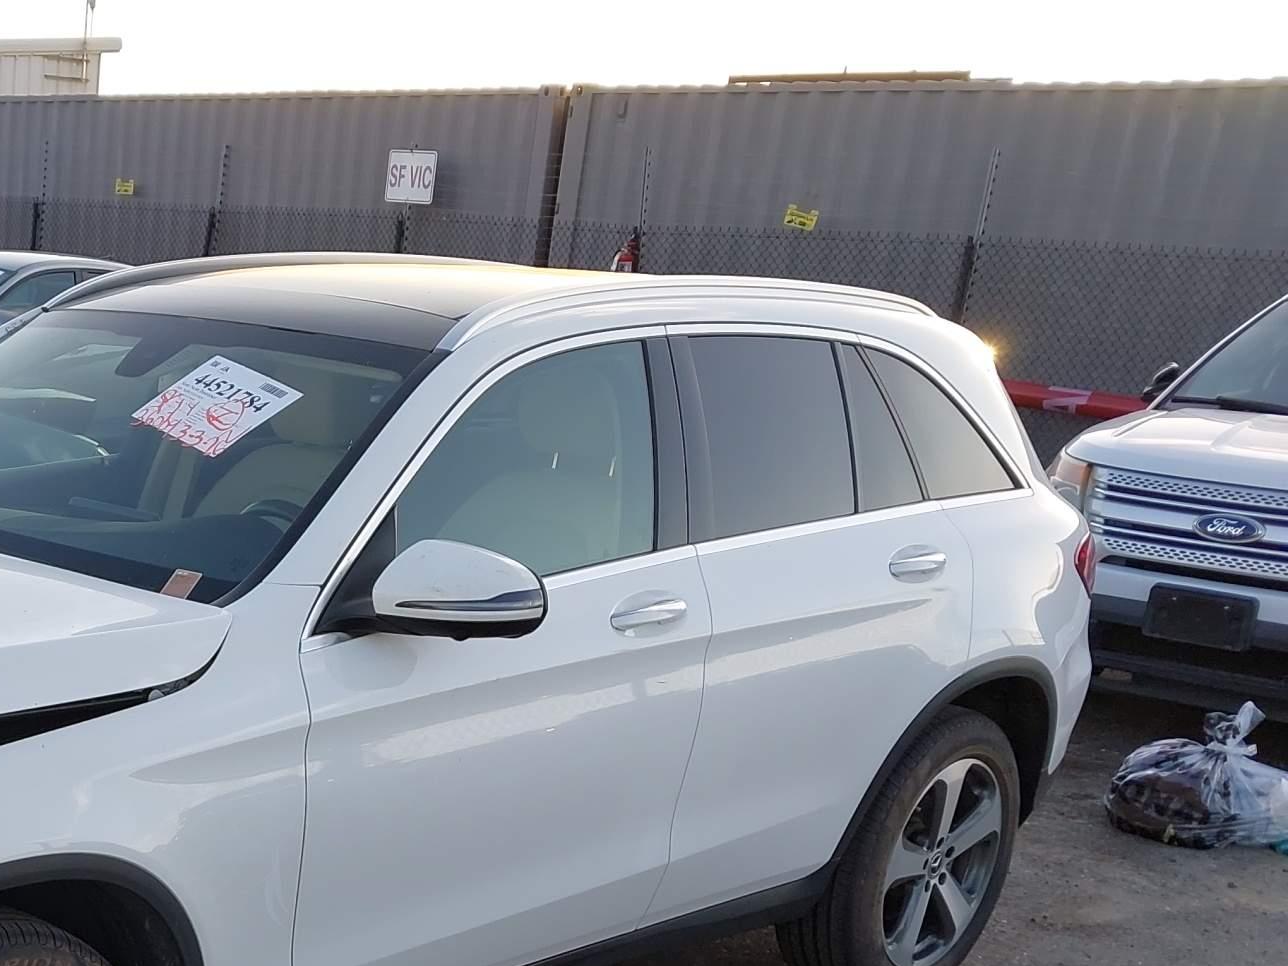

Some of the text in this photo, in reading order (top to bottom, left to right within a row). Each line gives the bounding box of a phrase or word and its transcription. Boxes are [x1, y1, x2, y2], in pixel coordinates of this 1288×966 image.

[389, 163, 432, 190] SF VIC
[194, 373, 272, 413] 44521784
[1207, 517, 1247, 535] Ford
